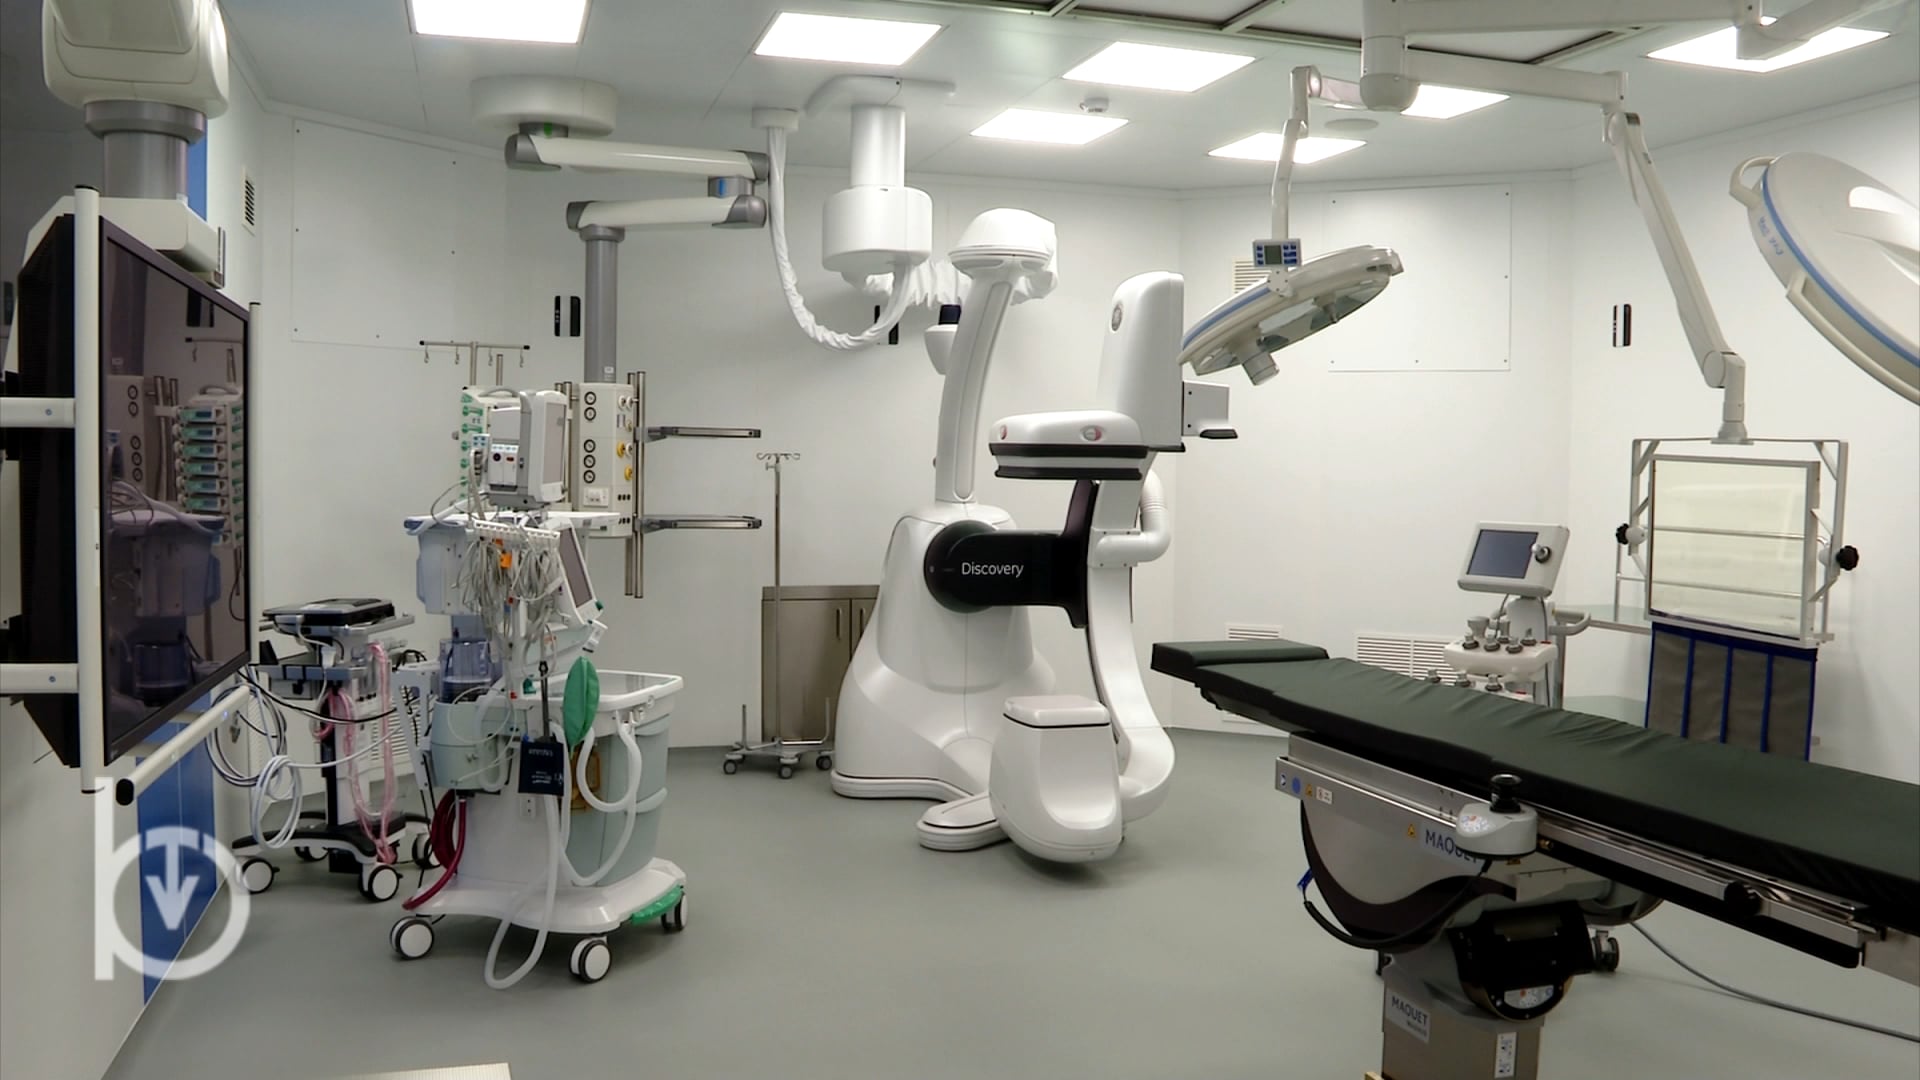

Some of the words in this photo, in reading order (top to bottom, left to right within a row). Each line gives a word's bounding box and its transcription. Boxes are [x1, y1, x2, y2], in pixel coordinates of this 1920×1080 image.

[961, 561, 1024, 578] Discovery
[1425, 829, 1477, 863] MAQU
[1391, 995, 1428, 1026] MAQUET
